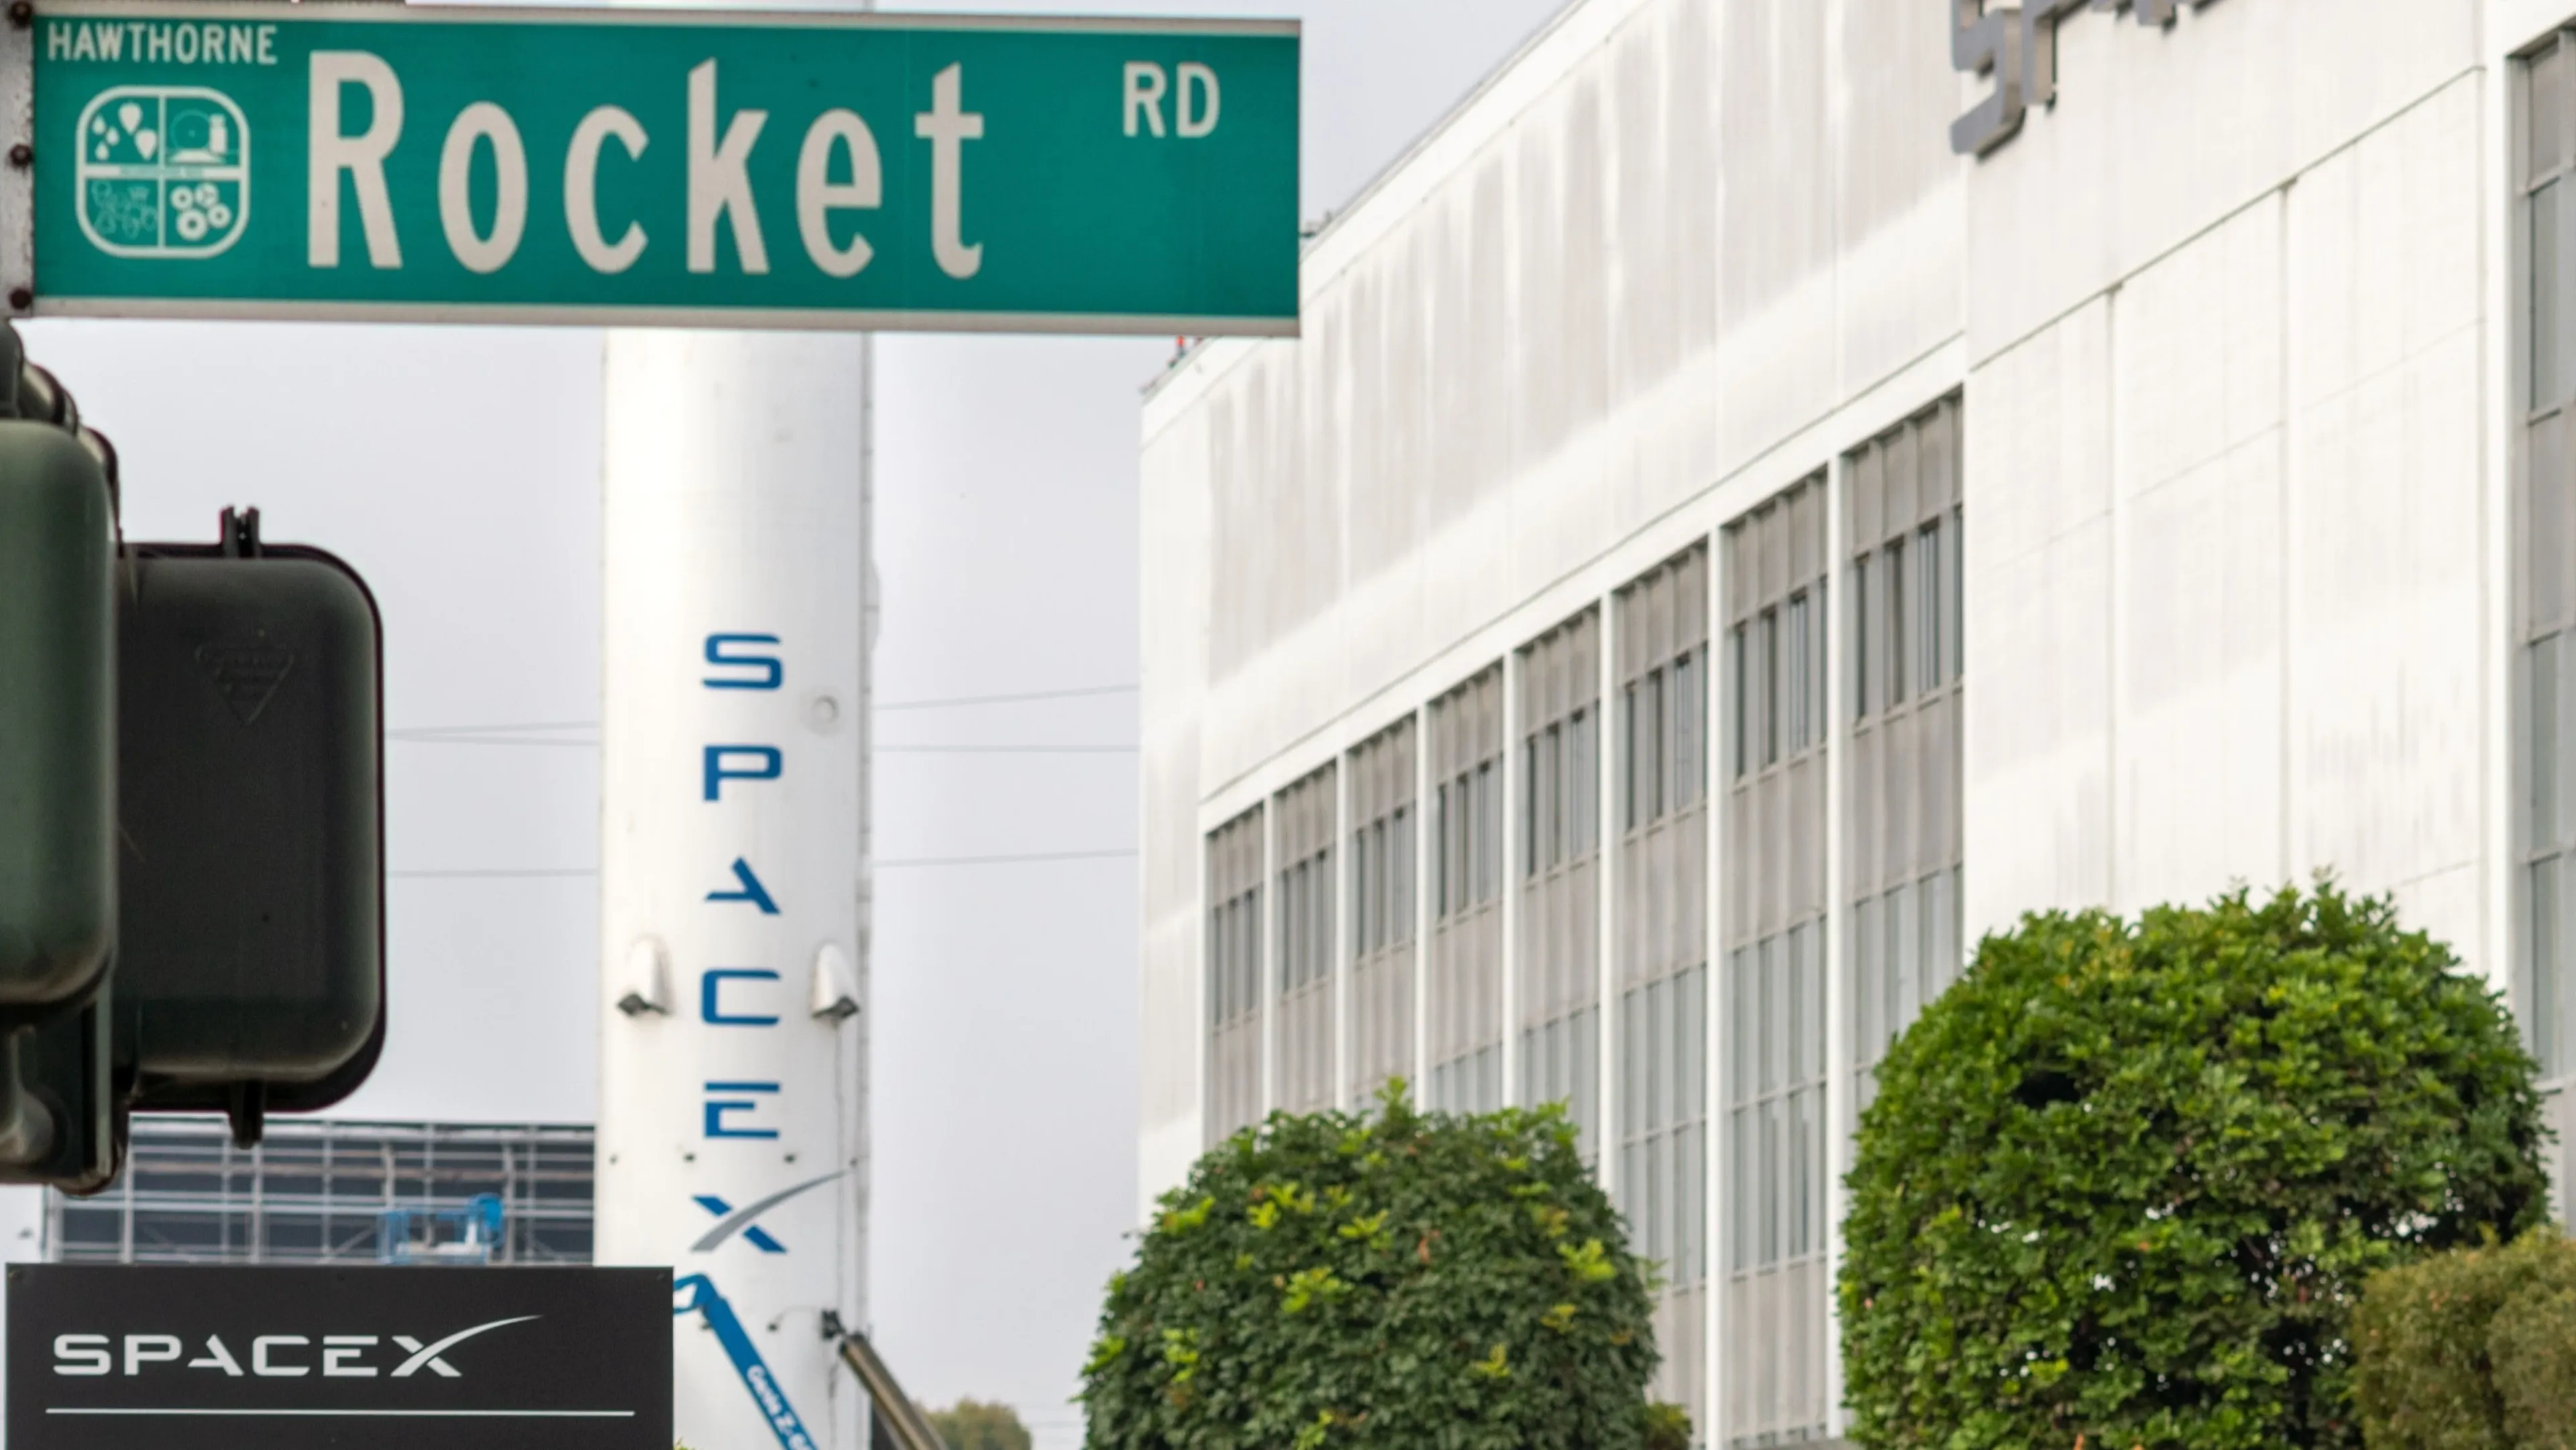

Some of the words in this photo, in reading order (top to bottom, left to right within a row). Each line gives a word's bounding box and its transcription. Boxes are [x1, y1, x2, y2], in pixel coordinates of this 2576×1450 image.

[47, 22, 278, 65] HAWTHORNE
[1122, 60, 1222, 138] RD
[307, 49, 985, 279] Rocket
[690, 633, 847, 1255] SPACEX
[52, 1314, 542, 1378] SPACEX
